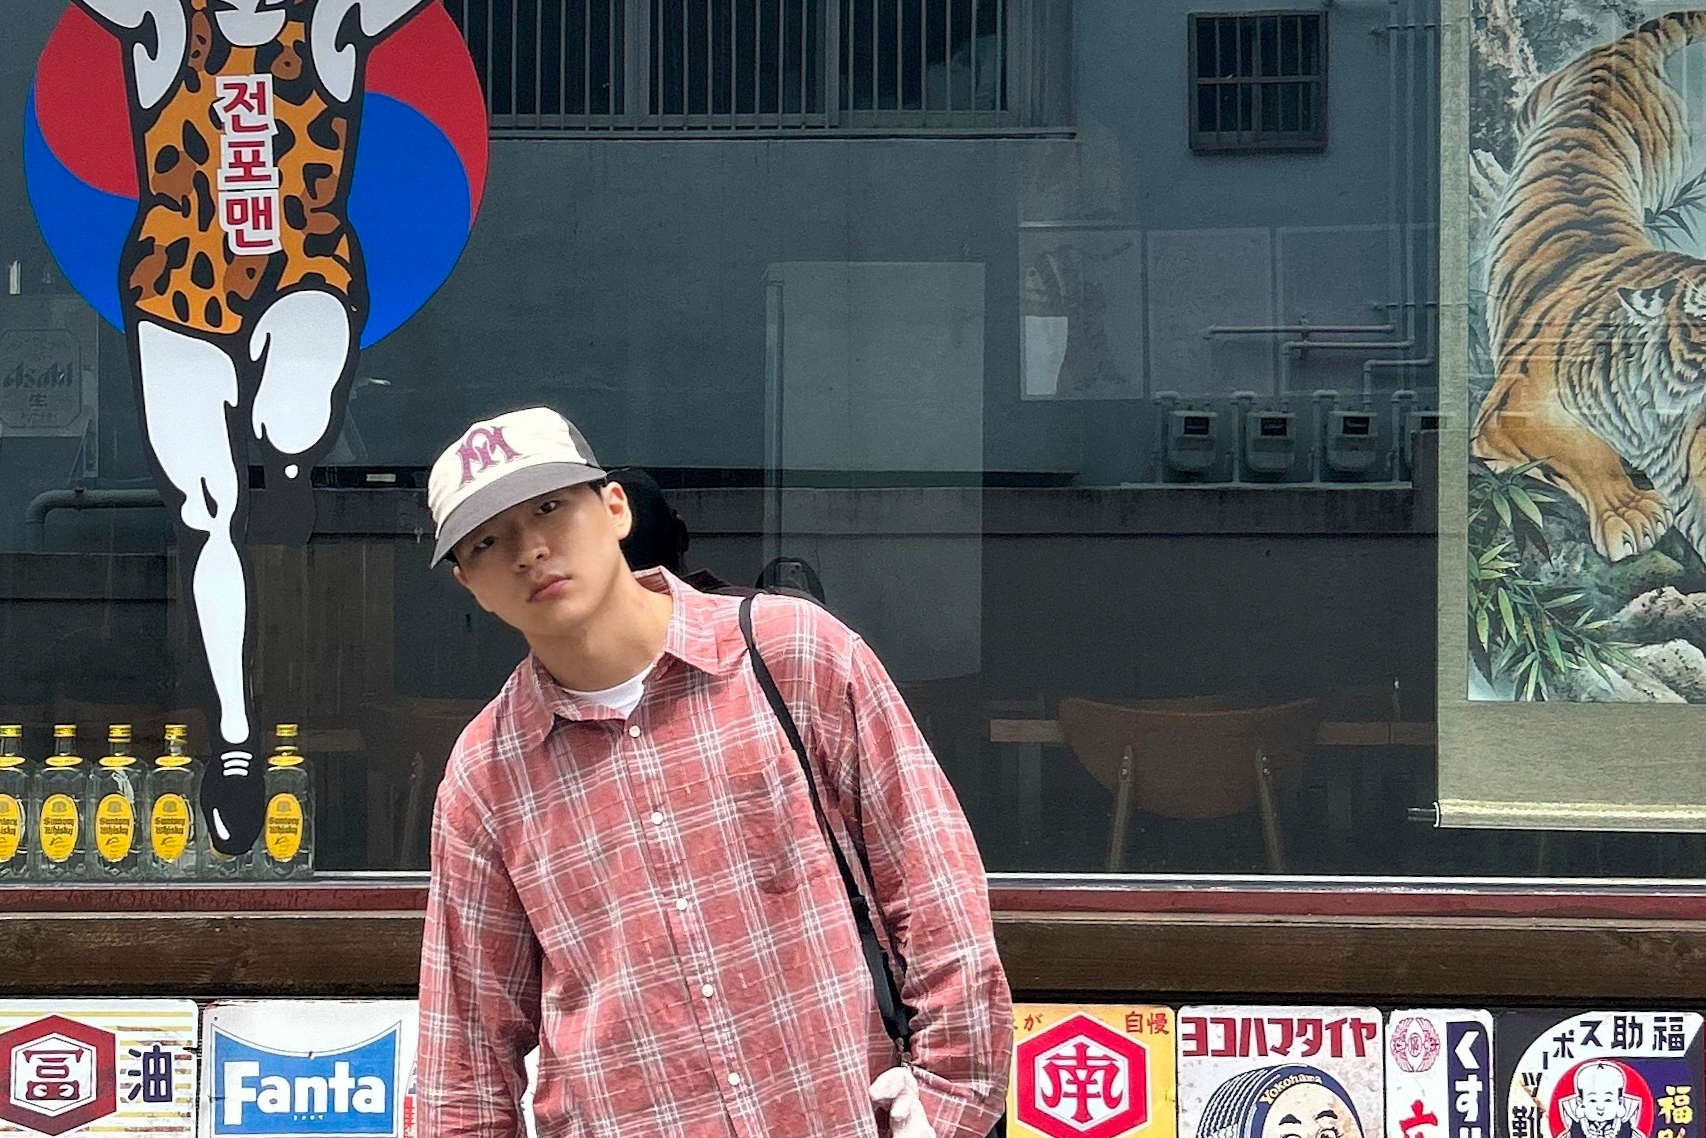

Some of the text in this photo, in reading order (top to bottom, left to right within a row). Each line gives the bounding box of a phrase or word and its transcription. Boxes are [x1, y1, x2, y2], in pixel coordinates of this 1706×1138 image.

[223, 81, 273, 248] 전포맨
[44, 818, 75, 827] Suntory
[100, 818, 130, 827] Suntory
[154, 817, 186, 826] Suntory
[269, 817, 299, 826] Suntory
[44, 826, 74, 836] Whisky
[100, 827, 129, 836] Whisky
[155, 826, 184, 835] Whisky
[269, 826, 299, 835] Whisky
[1125, 1011, 1169, 1035] 自慢
[1182, 1017, 1377, 1058] ヨコハマタイヤ
[119, 1045, 172, 1102] 油
[223, 1060, 386, 1125] Fanta
[1259, 1074, 1323, 1104] Yokohama
